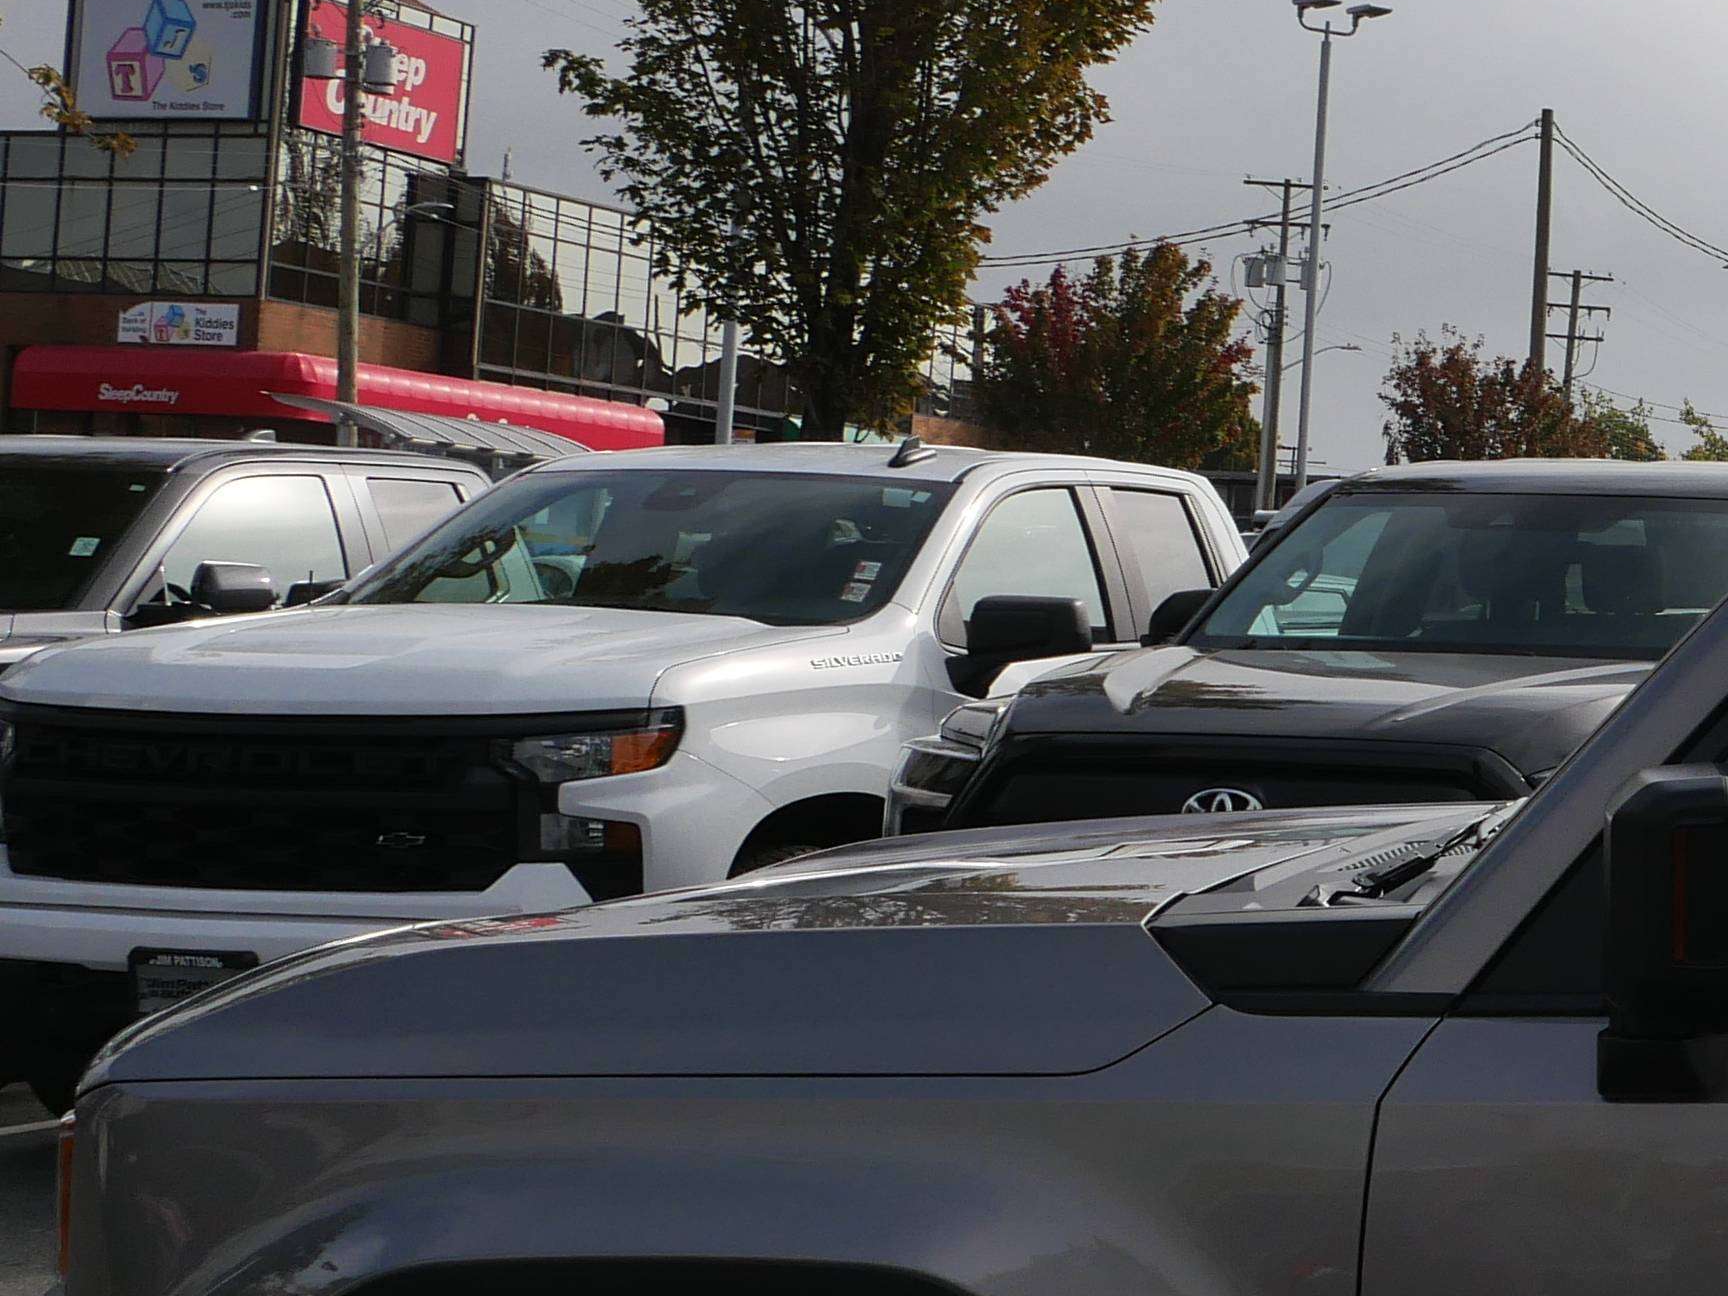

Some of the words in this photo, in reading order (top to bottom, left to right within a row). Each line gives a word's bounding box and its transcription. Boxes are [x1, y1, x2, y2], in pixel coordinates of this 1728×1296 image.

[114, 63, 136, 94] T
[152, 101, 167, 111] The
[202, 101, 226, 112] Store
[194, 317, 235, 331] Kiddies
[193, 329, 224, 342] Store
[808, 651, 905, 671] SILVERADO
